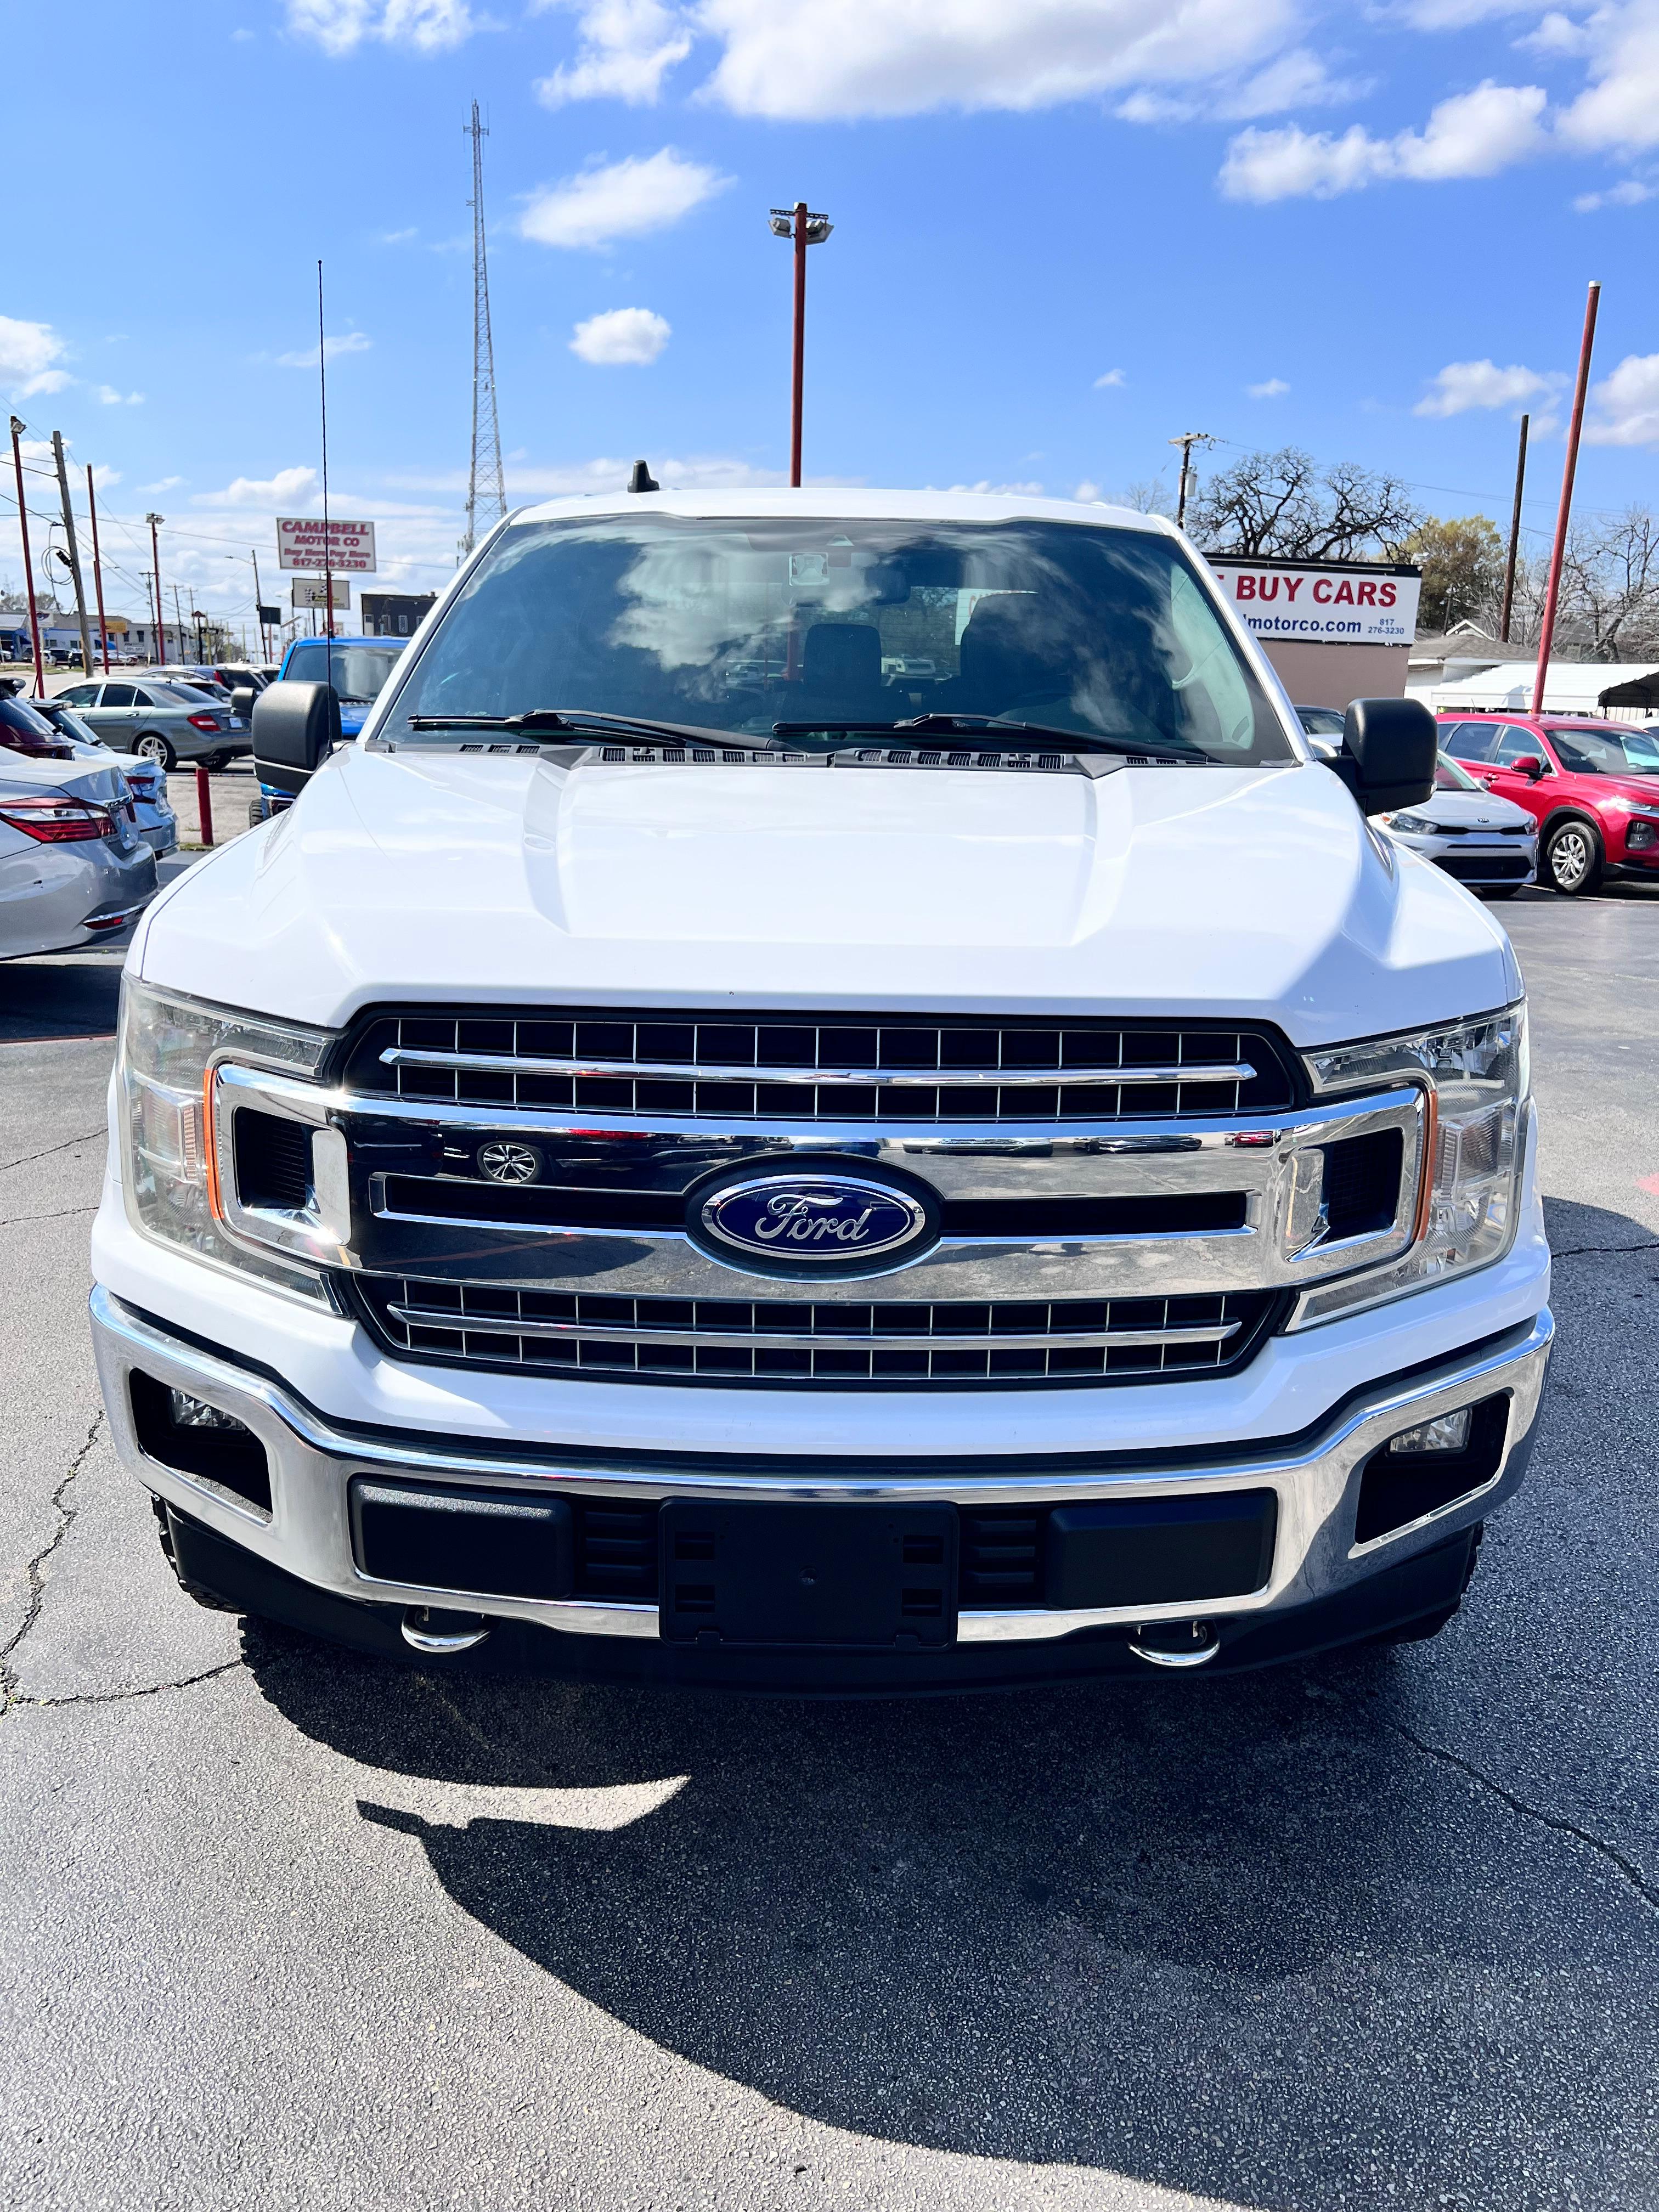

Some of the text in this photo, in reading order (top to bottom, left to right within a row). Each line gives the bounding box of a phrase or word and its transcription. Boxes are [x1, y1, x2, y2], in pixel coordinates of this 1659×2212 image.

[282, 521, 369, 535] CAMPBELL
[294, 535, 360, 546] MOTOR CO
[330, 550, 347, 559] Pay
[293, 557, 366, 568] 817-276-3230
[1236, 575, 1397, 608] BUY CARS
[1368, 626, 1405, 635] 276-3230
[755, 1194, 873, 1240] Ford
